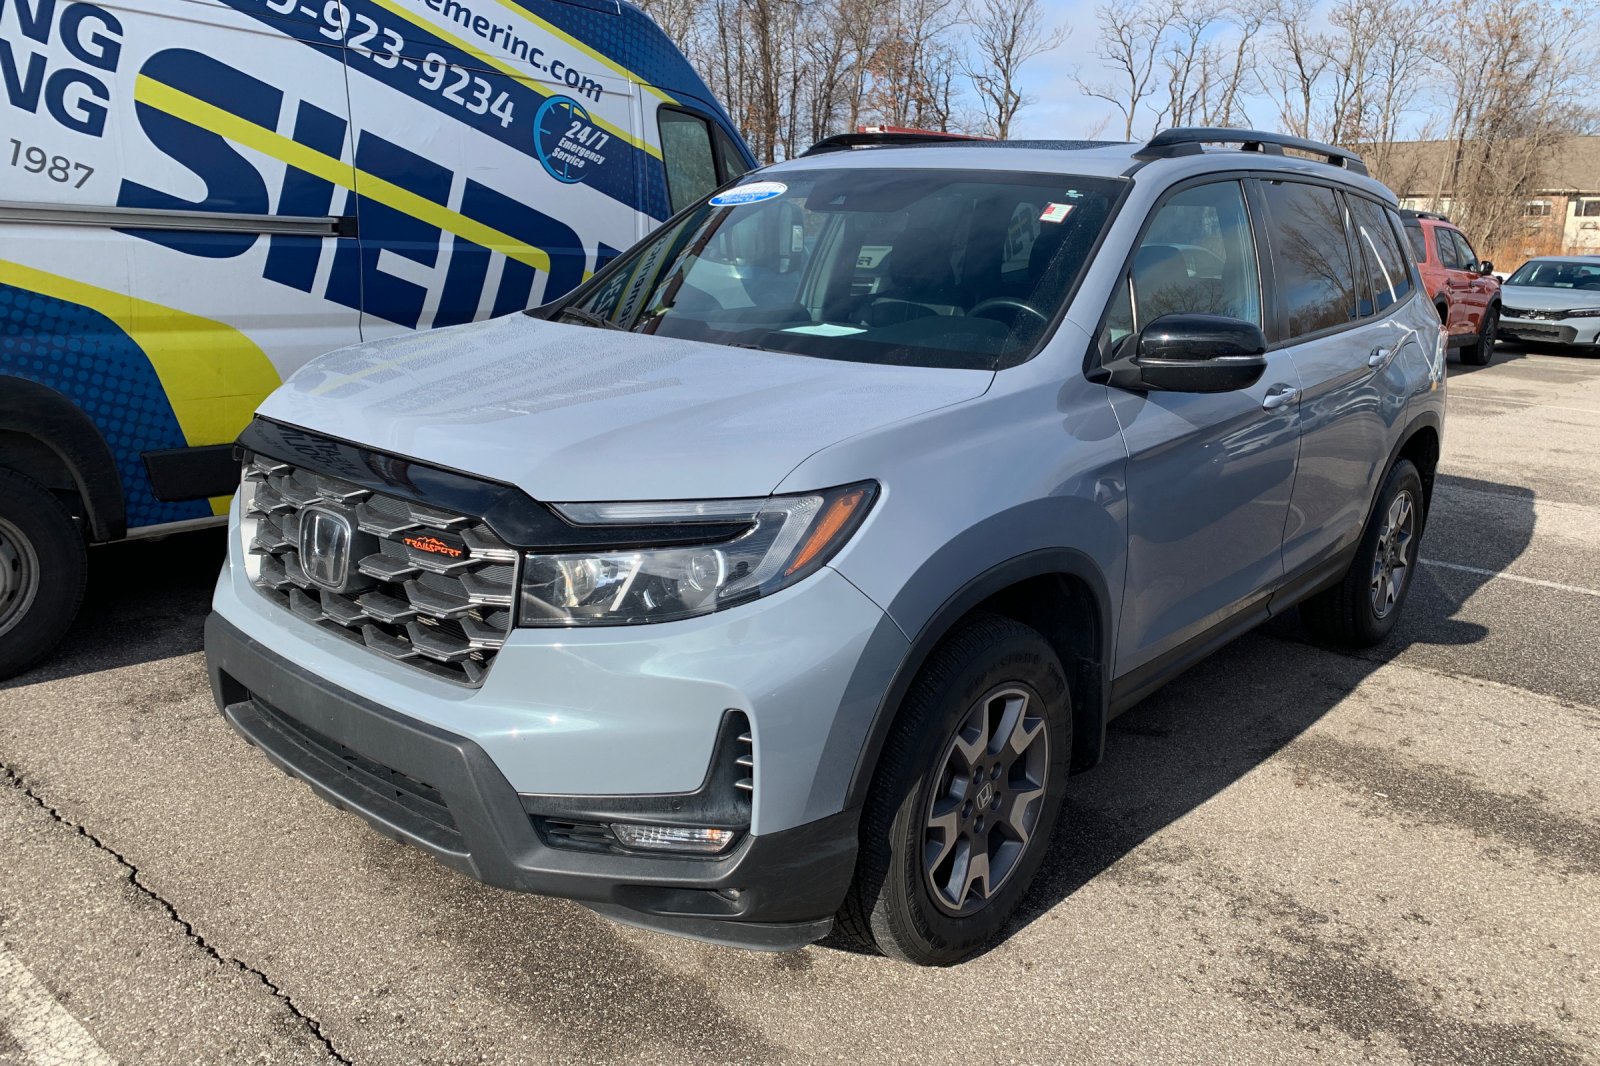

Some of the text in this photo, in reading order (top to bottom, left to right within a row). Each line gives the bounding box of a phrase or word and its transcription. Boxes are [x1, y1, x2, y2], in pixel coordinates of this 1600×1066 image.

[417, 0, 604, 103] emerinc.com
[565, 121, 610, 151] 24/7
[10, 138, 95, 189] 1987
[551, 147, 586, 168] Service
[558, 137, 606, 165] Emergency
[404, 537, 462, 557] TRAILSPORT
